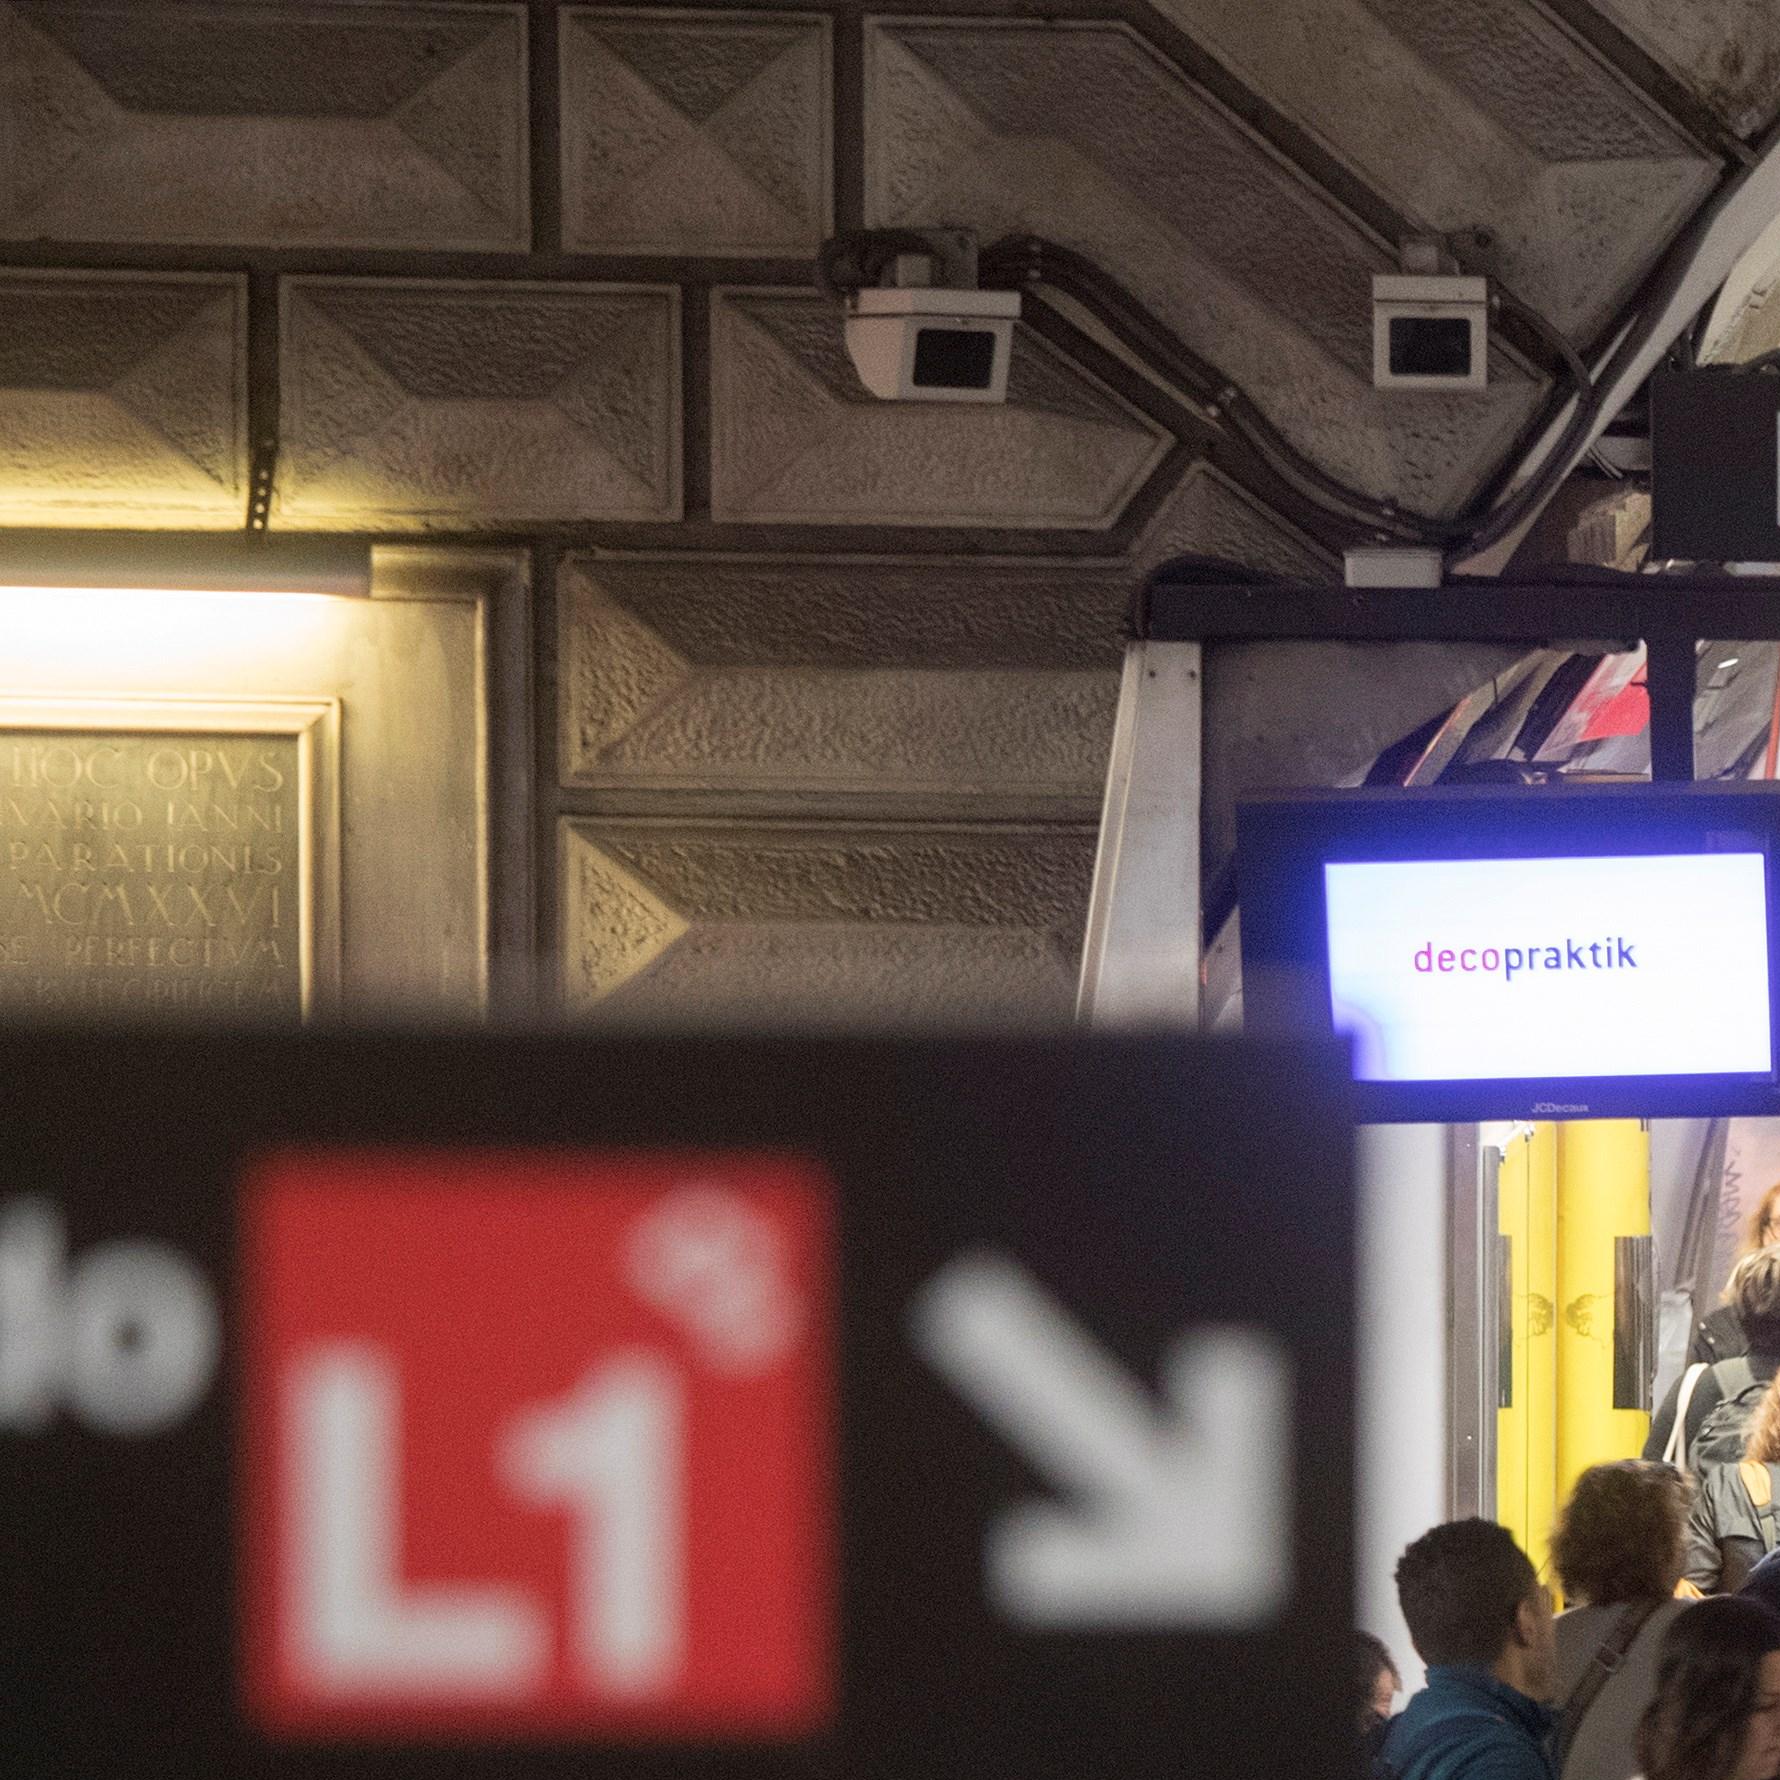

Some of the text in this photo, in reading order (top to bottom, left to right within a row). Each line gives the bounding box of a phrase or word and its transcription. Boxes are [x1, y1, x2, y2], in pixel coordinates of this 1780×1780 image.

[148, 748, 284, 793] OPVS
[1413, 937, 1638, 981] decopraktik
[1530, 1102, 1590, 1114] JCDecaux
[280, 1337, 692, 1706] L1
